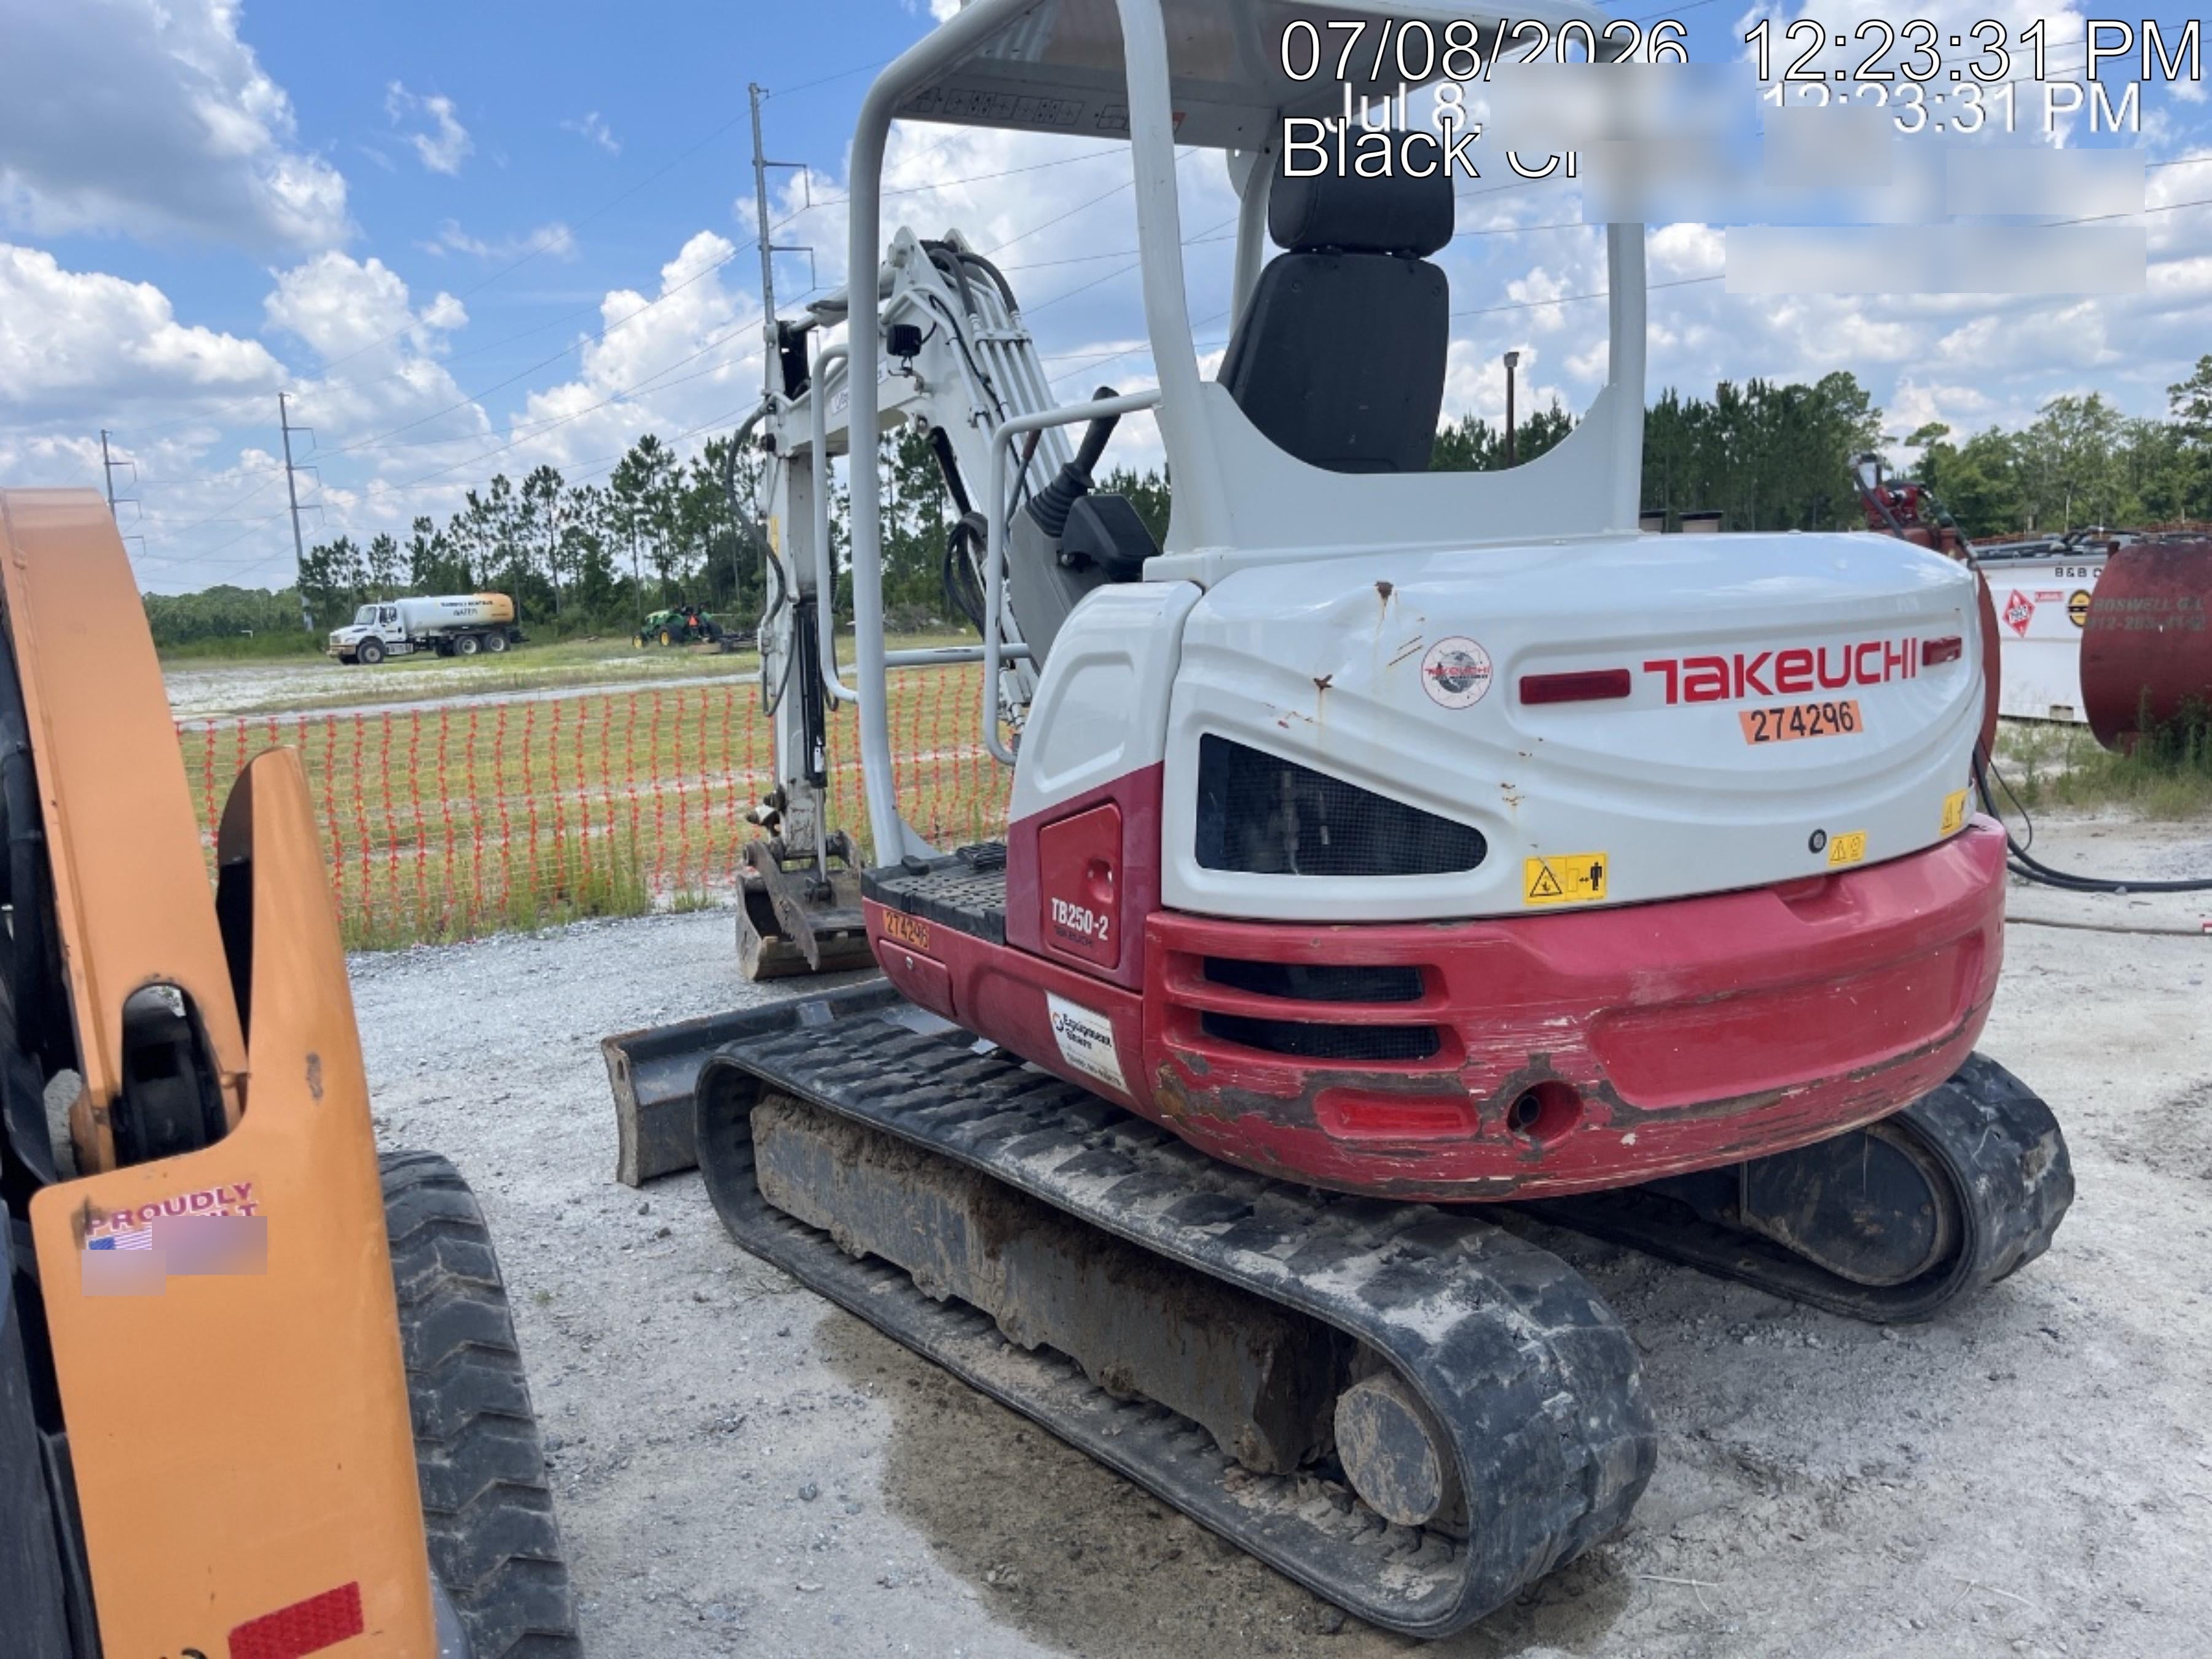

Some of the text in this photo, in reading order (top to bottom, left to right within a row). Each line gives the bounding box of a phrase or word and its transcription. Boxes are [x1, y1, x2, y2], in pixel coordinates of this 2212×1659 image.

[1644, 637, 1916, 704] TAKEUCHI
[1751, 701, 1854, 742] 274296
[1051, 897, 1108, 941] TB250-2
[85, 1182, 254, 1236] PROUDLY
